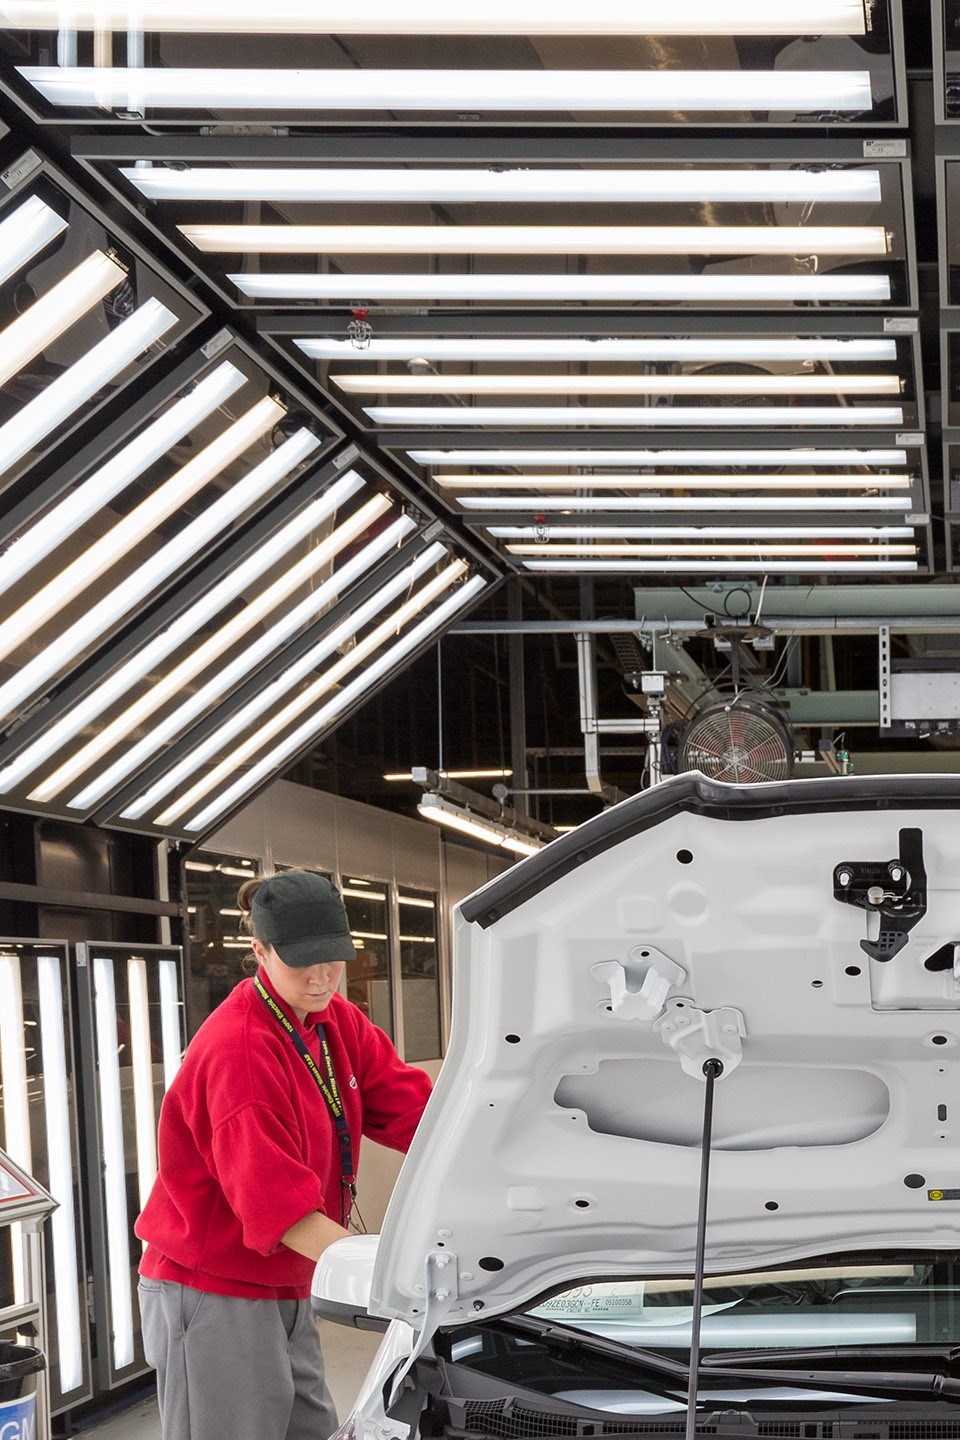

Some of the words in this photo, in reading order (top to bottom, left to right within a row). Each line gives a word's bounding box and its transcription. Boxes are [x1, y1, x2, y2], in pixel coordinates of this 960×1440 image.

[267, 998, 284, 1019] Electric
[282, 1018, 294, 1033] 100%
[303, 1054, 314, 1069] LEAF
[325, 1055, 334, 1077] Electric
[312, 1066, 325, 1085] Nissan
[321, 1084, 335, 1104] Electric
[329, 1078, 338, 1098] Nissan
[331, 1101, 341, 1117] 100%
